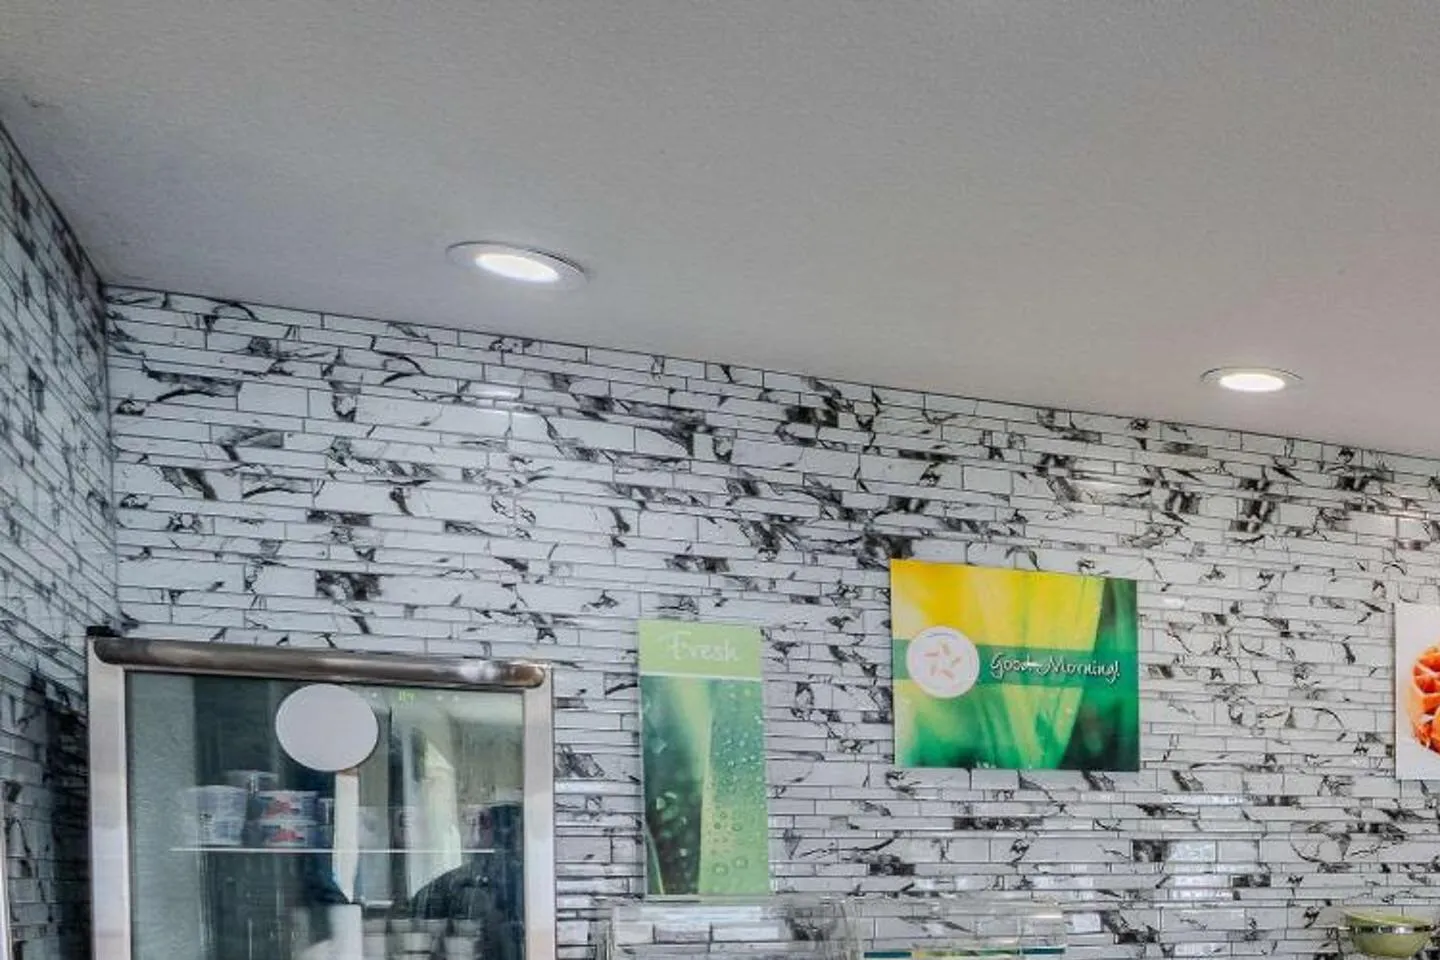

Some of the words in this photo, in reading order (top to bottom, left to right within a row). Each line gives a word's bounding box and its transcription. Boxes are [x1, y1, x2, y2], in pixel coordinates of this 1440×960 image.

[657, 630, 740, 662] Fresh
[990, 652, 1032, 679] Good
[1035, 656, 1120, 685] Morning!
